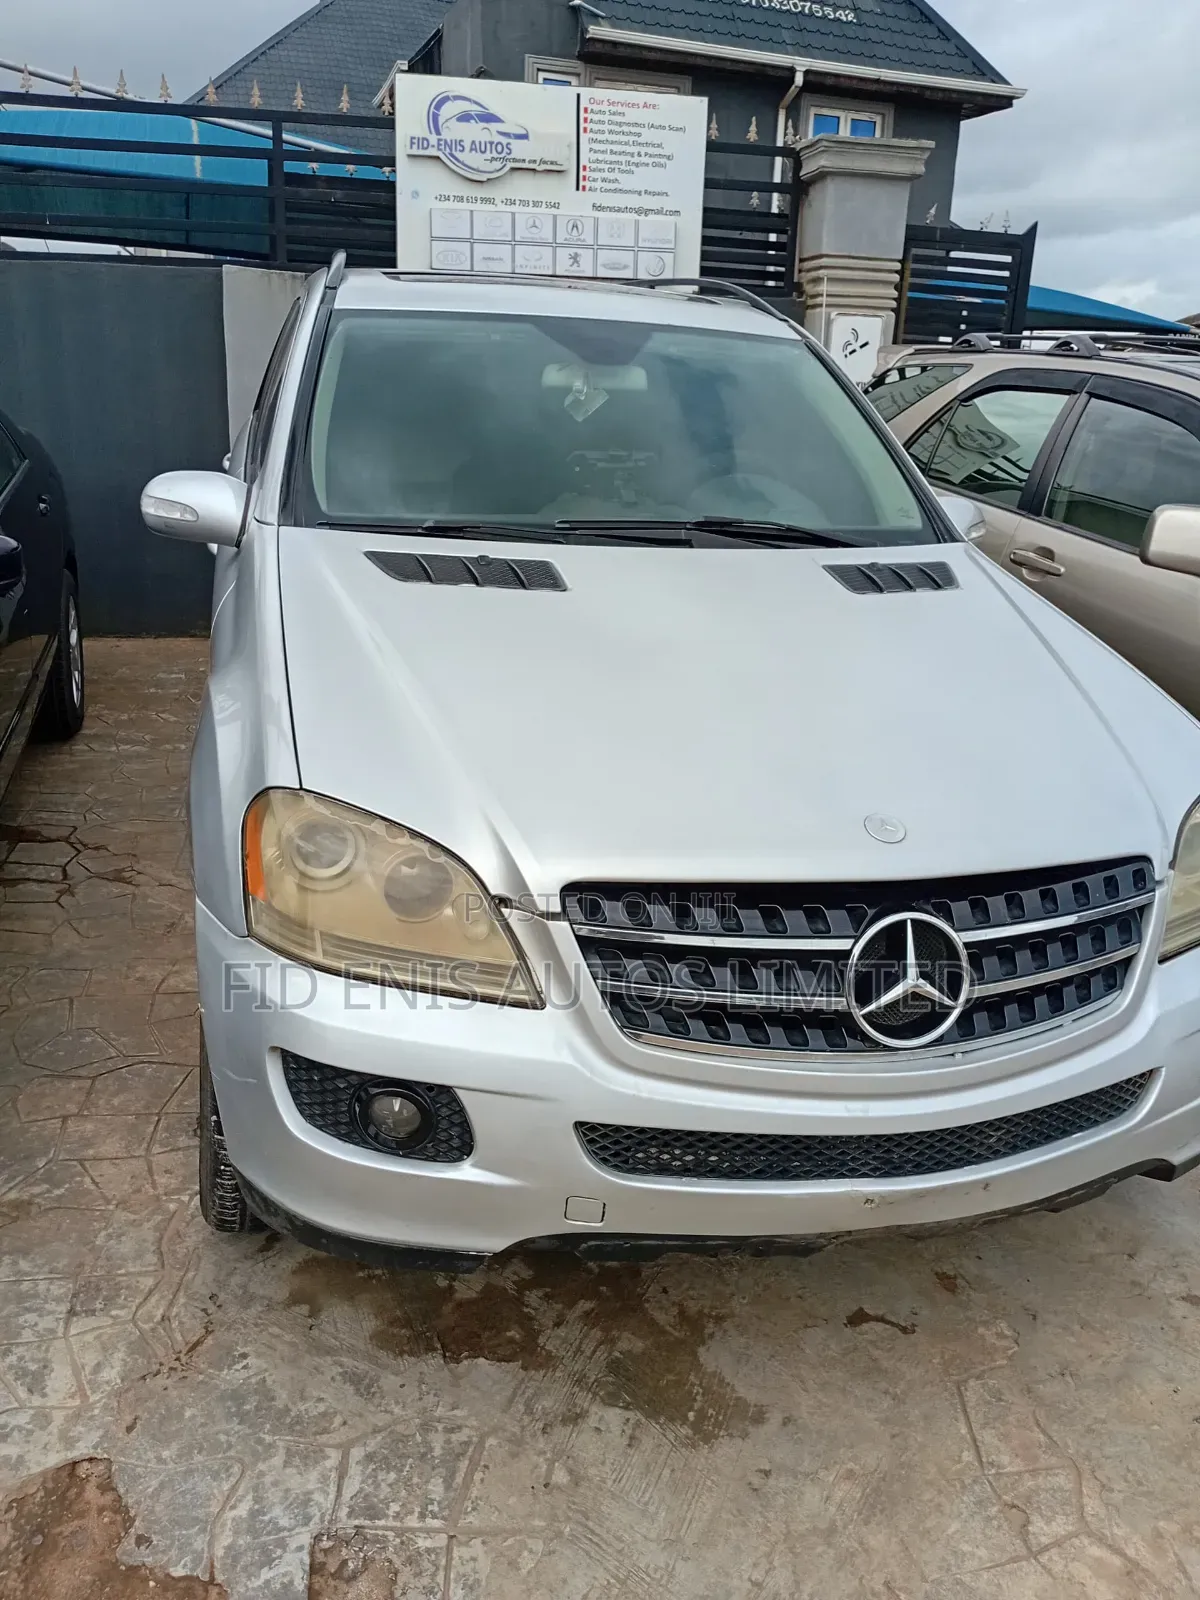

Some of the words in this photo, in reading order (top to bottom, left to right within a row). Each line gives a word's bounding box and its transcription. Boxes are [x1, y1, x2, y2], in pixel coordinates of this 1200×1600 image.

[588, 97, 604, 105] Our
[606, 98, 640, 109] Services
[642, 101, 660, 110] Are:
[589, 108, 606, 116] Auto
[608, 109, 626, 117] Sales
[588, 118, 606, 126] Auto
[607, 119, 646, 129] Diagnostics
[647, 122, 667, 131] (Auto
[667, 124, 686, 133] Scan)
[588, 127, 606, 135] Auto
[607, 128, 642, 138] Workshop
[409, 136, 465, 153] FID-ENIS
[469, 139, 513, 156] AUTOS
[588, 147, 608, 156] Panel
[609, 148, 635, 158] Beating
[636, 150, 642, 158] &
[643, 151, 674, 161] Painting)
[588, 157, 623, 166] Lubricants
[624, 159, 650, 169] (Engine
[651, 161, 667, 170] Oils)
[607, 166, 616, 174] Of
[616, 167, 634, 175] Tools
[587, 175, 599, 183] Car
[600, 176, 621, 184] Wash.
[588, 185, 598, 193] Air
[599, 186, 642, 196] Conditioning
[643, 188, 670, 198] Repairs.
[434, 194, 451, 202] +234
[452, 195, 465, 203] 708
[466, 195, 478, 204] 619
[500, 197, 517, 206] +234
[518, 198, 530, 208] 703
[531, 199, 543, 208] 307
[544, 200, 561, 210] 5542
[592, 202, 681, 217] fidenisautos@gmail.com
